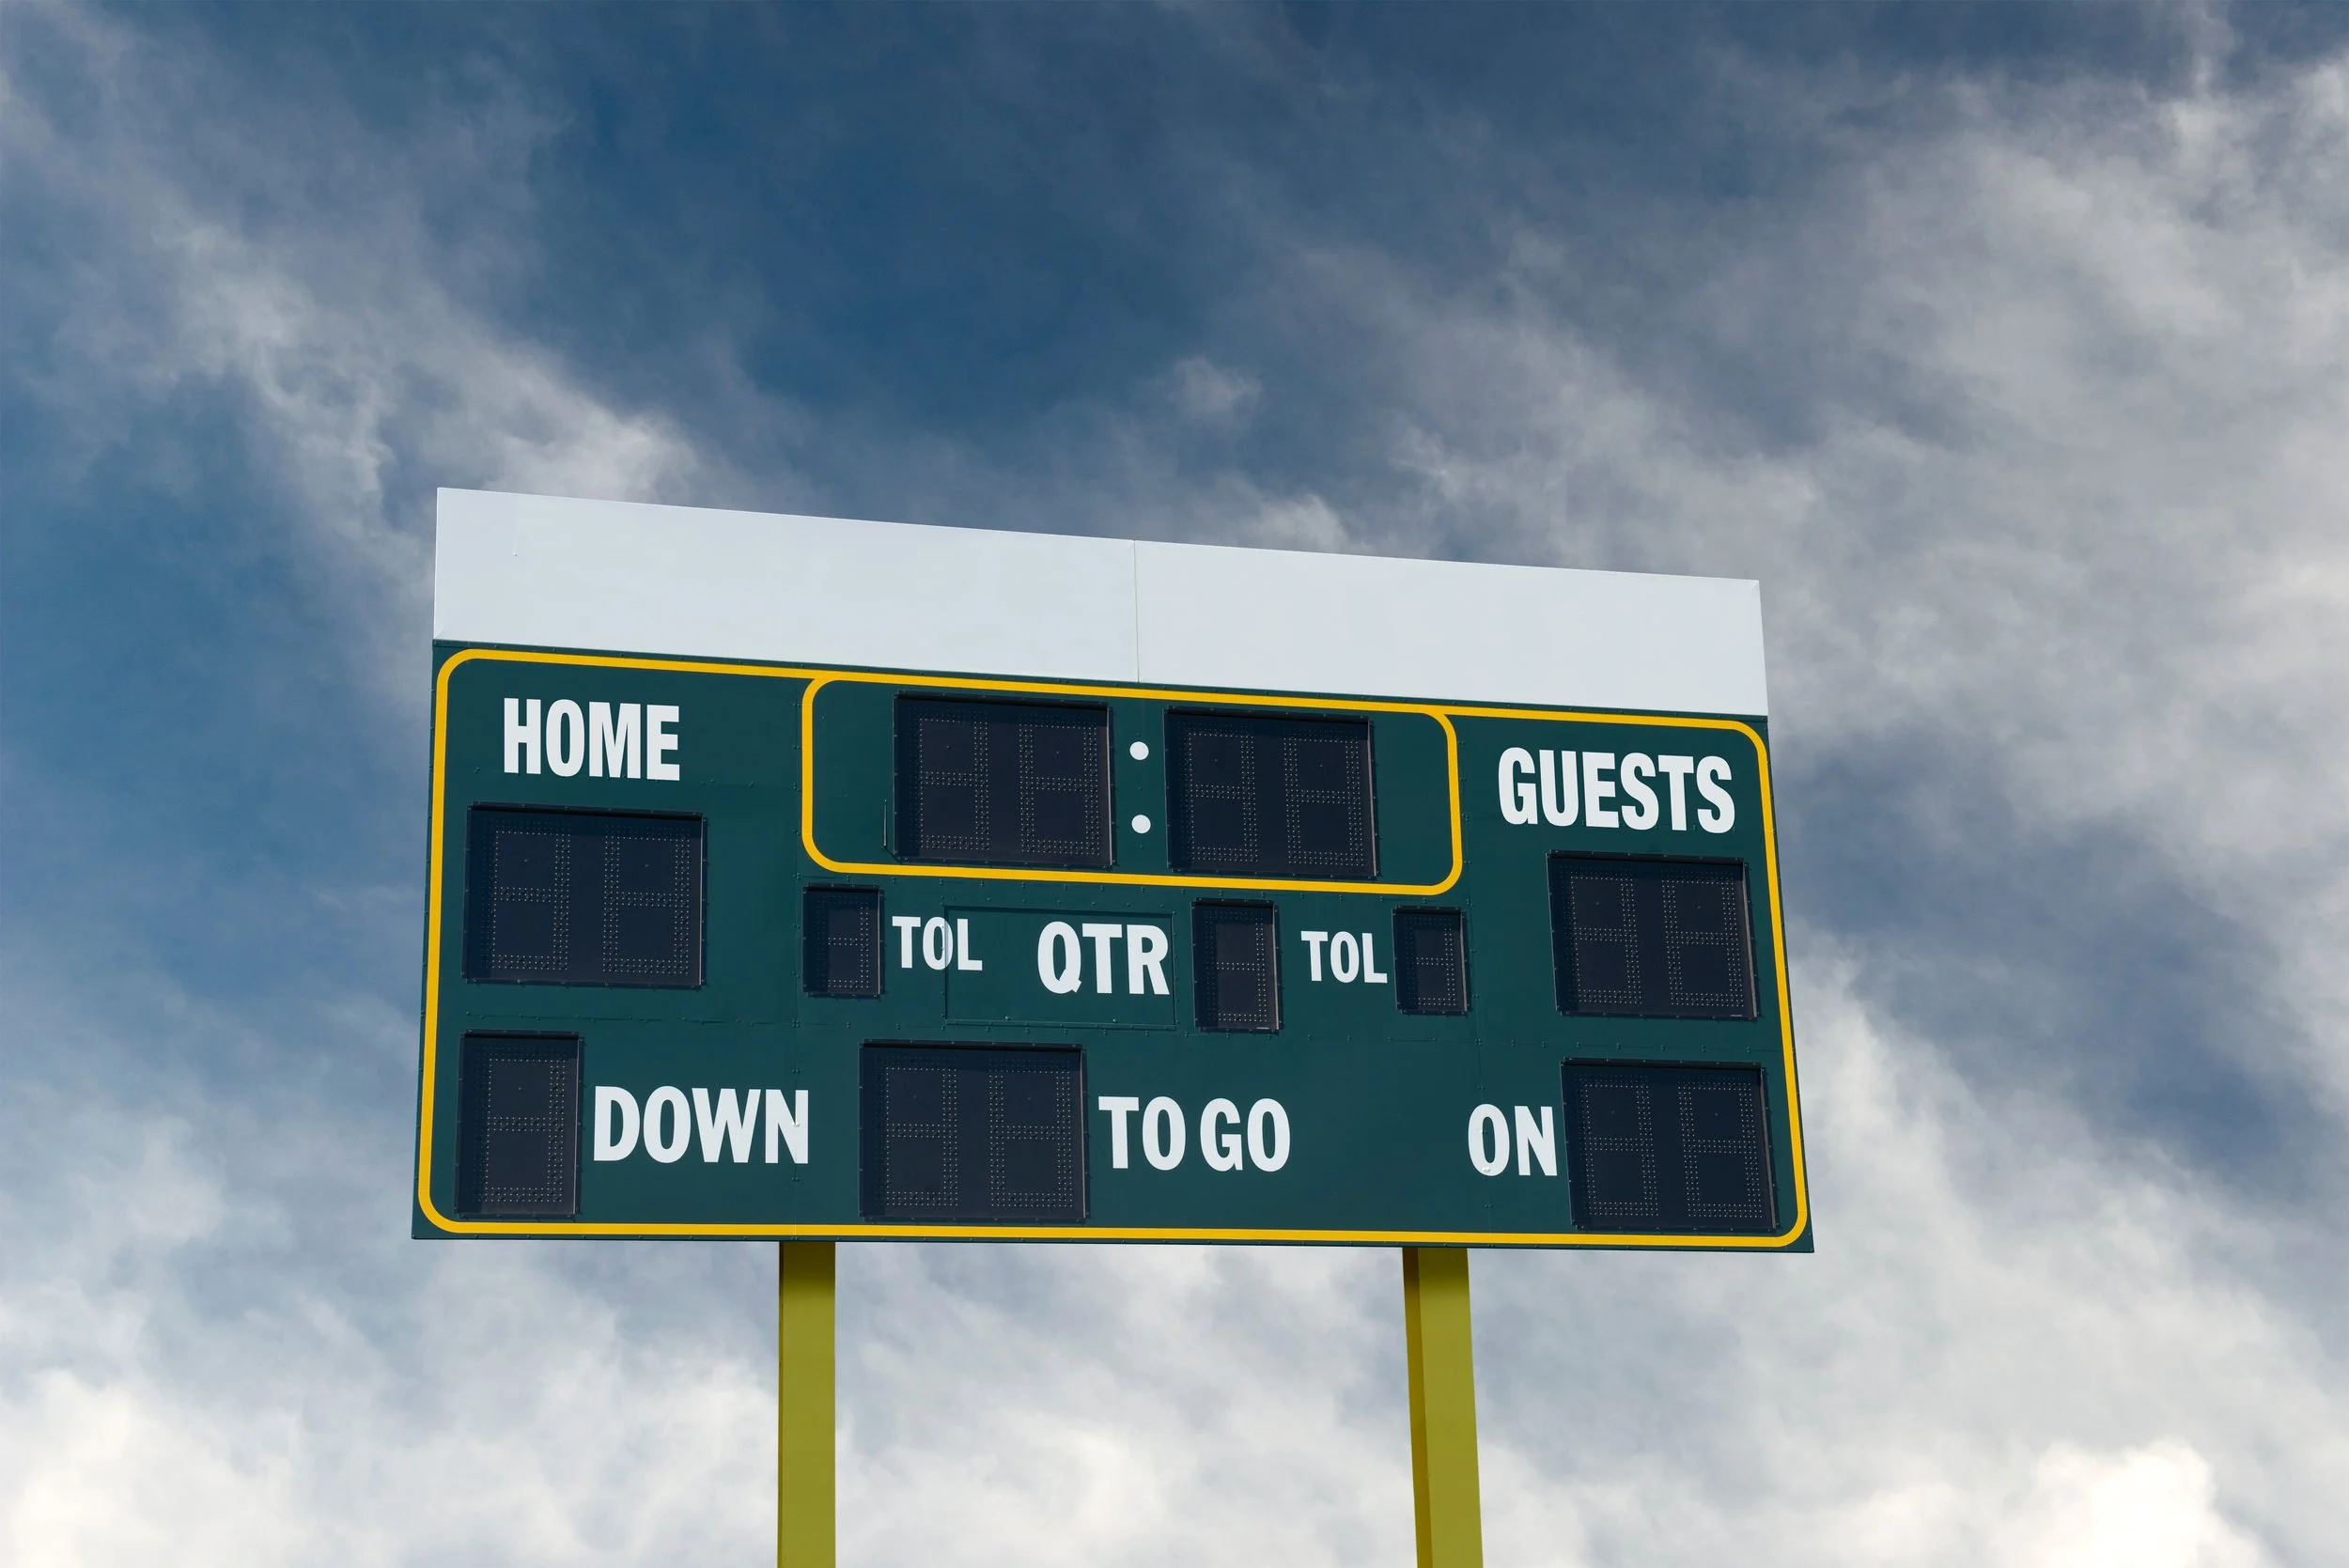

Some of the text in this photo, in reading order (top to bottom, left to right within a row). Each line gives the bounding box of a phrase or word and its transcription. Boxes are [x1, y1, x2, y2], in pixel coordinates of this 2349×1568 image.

[504, 697, 680, 782] HOME
[1498, 747, 1735, 834] GUESTS
[892, 915, 983, 971] TOL
[1037, 921, 1170, 995] QTR
[1300, 930, 1388, 984] TOL
[593, 1085, 809, 1164] DOWN
[1097, 1095, 1291, 1172] TO GO
[1468, 1103, 1558, 1176] ON
